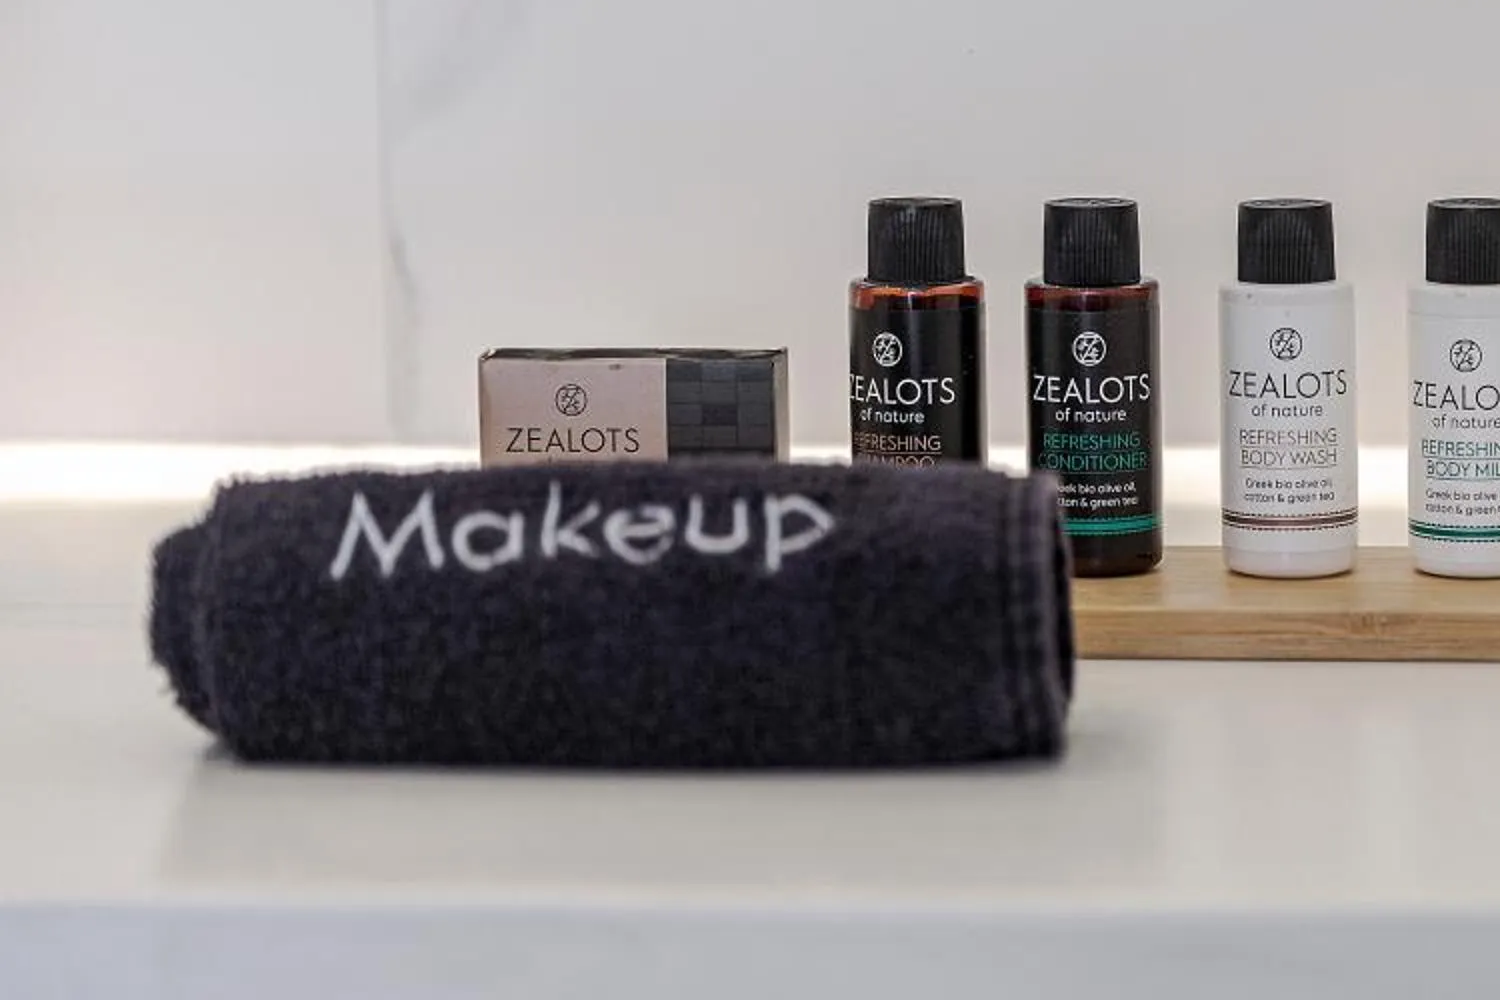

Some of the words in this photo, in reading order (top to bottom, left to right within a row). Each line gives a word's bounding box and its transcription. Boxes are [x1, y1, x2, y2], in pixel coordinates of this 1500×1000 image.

[1033, 373, 1150, 404] ZEALOTS
[1228, 369, 1347, 399] ZEALOTS
[859, 407, 872, 421] of
[875, 410, 925, 424] nature
[1055, 408, 1070, 422] of
[1074, 408, 1127, 422] nature
[1251, 404, 1268, 417] of
[1271, 404, 1323, 418] nature
[1432, 416, 1446, 430] of
[506, 427, 640, 453] ZEALOTS
[1043, 431, 1141, 451] REFRESHING
[1240, 428, 1337, 446] REFRESHING
[854, 455, 934, 468] AMPOO
[1039, 452, 1148, 471] CONDITIONER
[1241, 449, 1285, 466] BODY
[1290, 448, 1337, 465] WASH
[1427, 460, 1470, 477] BODY
[1078, 483, 1096, 494] bio
[1275, 479, 1293, 489] bio
[1080, 498, 1089, 508] &
[1454, 491, 1471, 501] bio
[330, 482, 834, 580] Makeup
